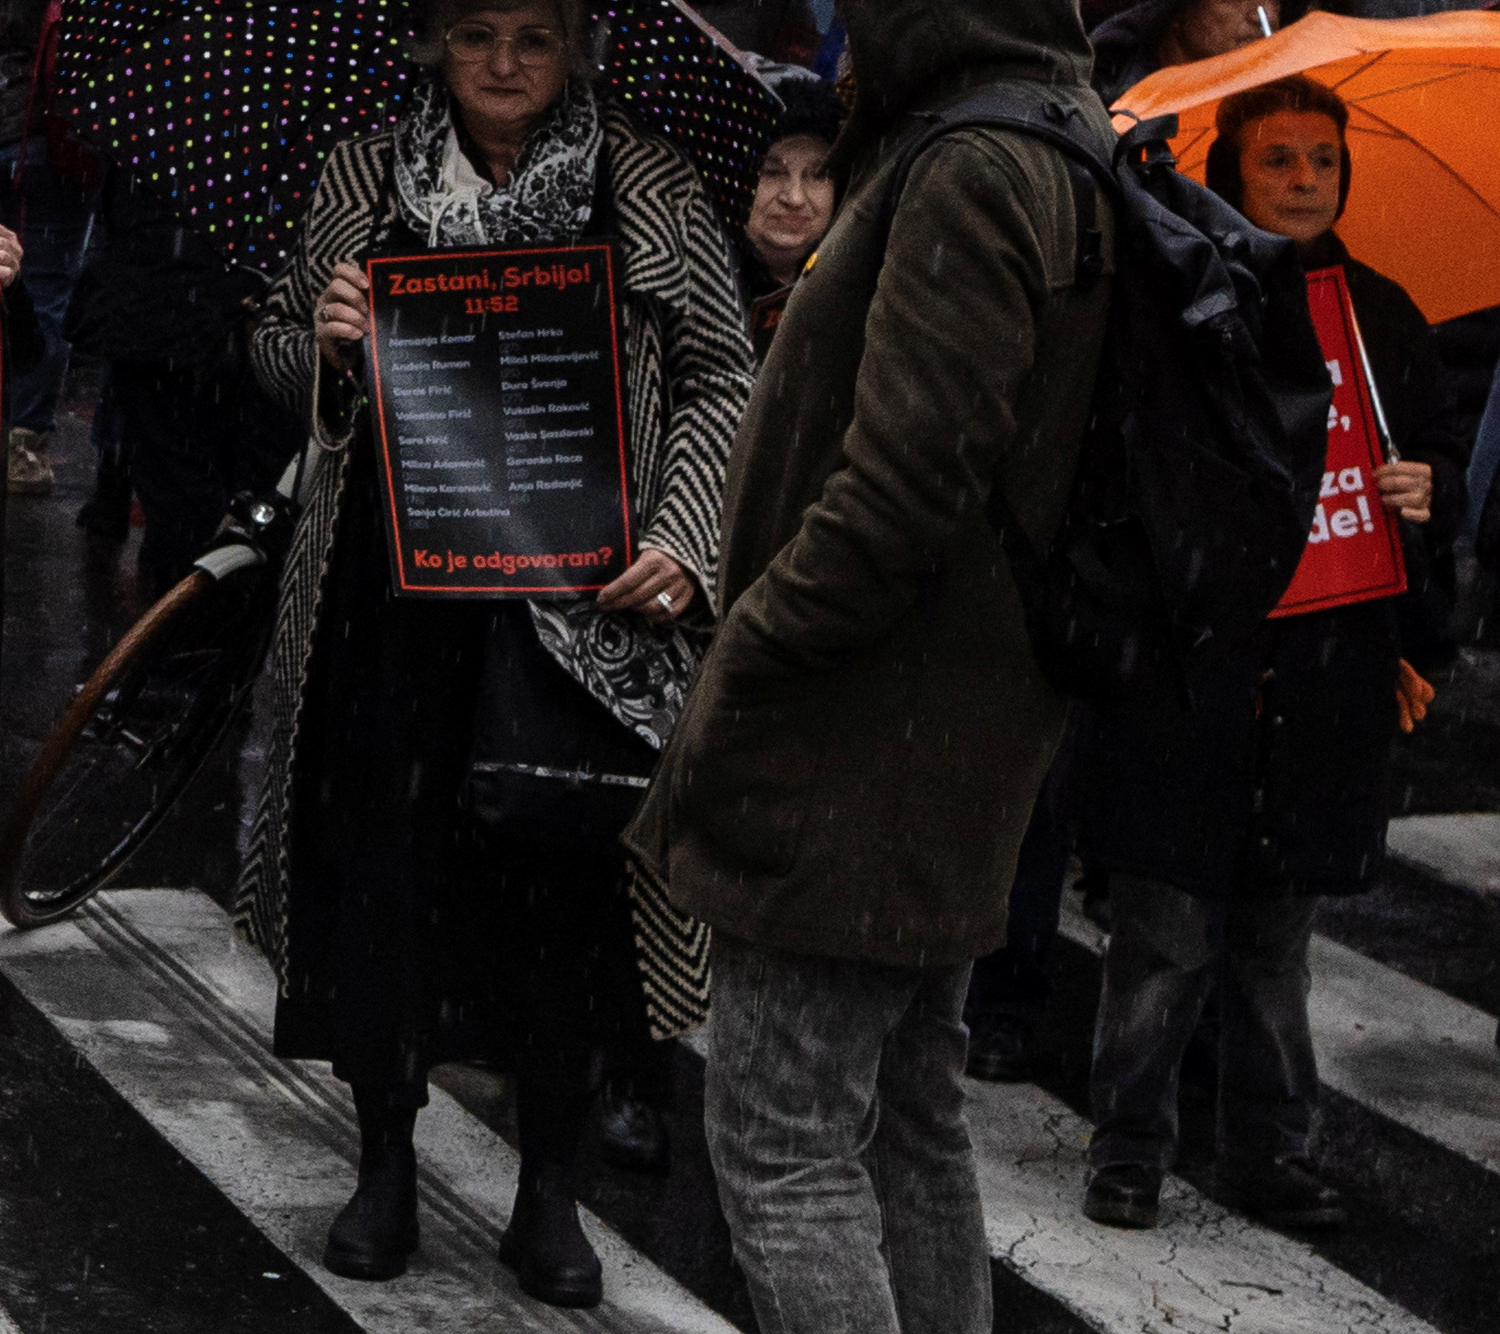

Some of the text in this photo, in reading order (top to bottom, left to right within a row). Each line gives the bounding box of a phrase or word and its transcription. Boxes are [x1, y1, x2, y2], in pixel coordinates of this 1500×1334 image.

[388, 263, 591, 295] Zastani, Srbijo!
[465, 295, 519, 314] 11:52
[1319, 466, 1364, 498] za
[414, 546, 613, 575] Ko je odgovoran?
